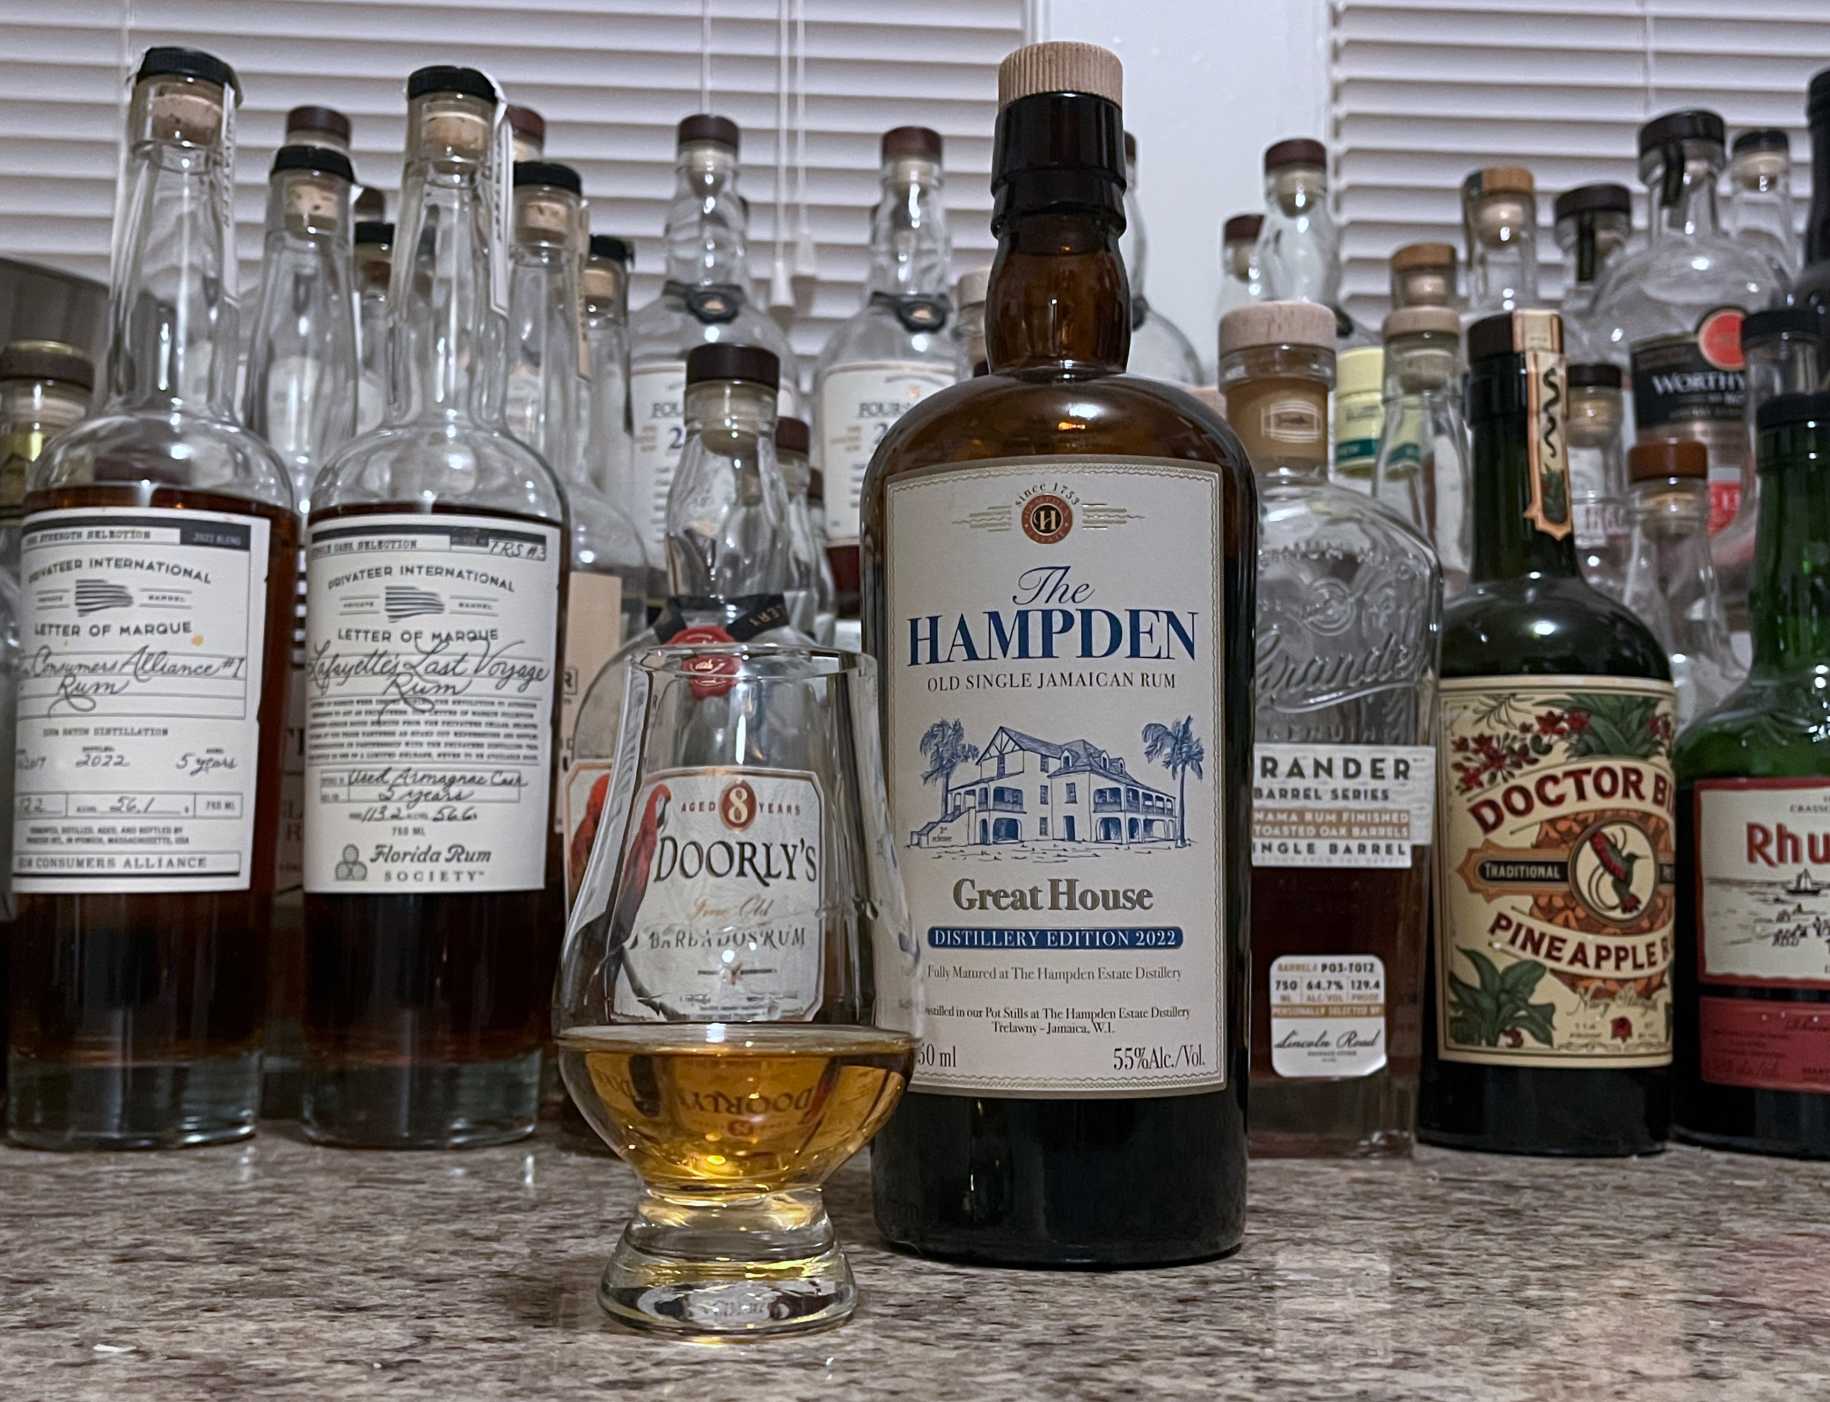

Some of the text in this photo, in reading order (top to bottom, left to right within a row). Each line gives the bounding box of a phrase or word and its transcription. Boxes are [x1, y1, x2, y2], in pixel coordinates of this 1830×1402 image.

[89, 556, 212, 585] INTERNATIONAL
[328, 564, 516, 593] PRIVATEER INTERNATIONAL
[1012, 566, 1096, 605] The
[34, 621, 193, 637] LETTER OF MARQUE
[338, 628, 499, 643] LETTER OF MARQUE
[907, 608, 1199, 667] HAMPDEN
[119, 644, 220, 683] Alliance
[472, 640, 550, 693] Voyage
[927, 672, 1176, 692] OLD SINGLE JAMAICAN RUM
[1260, 755, 1411, 781] RANDER
[1253, 787, 1390, 801] BARREL SERIES
[1467, 765, 1647, 836] DOCTOR
[680, 786, 801, 823] AGED 8 YEARS
[1254, 810, 1409, 824] NAMA RUM FINISHED
[1254, 824, 1409, 837] TOASTED OAK BARRELS
[369, 844, 493, 863] Florida Rum
[1253, 842, 1406, 856] INGLE BARREL
[36, 857, 117, 869] CONSUMERS
[123, 856, 208, 869] ALLIANCE
[653, 835, 818, 887] DOORLY'S
[1484, 862, 1561, 880] TRADITIONAL
[953, 877, 1154, 912] Great House
[934, 930, 1177, 947] DISTILLERY EDITION 2022
[1487, 912, 1658, 971] PINEAPPLE
[927, 964, 1184, 984] Fully Matured at The Hampden Estate Distillery
[1275, 979, 1380, 991] 750 64.7% 129.4
[956, 1006, 966, 1018] in
[966, 1008, 984, 1019] our
[985, 1006, 1001, 1019] Pot
[1003, 1005, 1029, 1019] Stills
[1030, 1008, 1040, 1020] at
[1042, 1007, 1064, 1020] The
[1066, 1008, 1116, 1024] Hampden
[1118, 1007, 1149, 1020] Estate
[1150, 1006, 1191, 1020] Distillery
[992, 1020, 1038, 1035] Trelawny
[1046, 1021, 1091, 1035] Jamaica,
[917, 1045, 957, 1067] 50 ml
